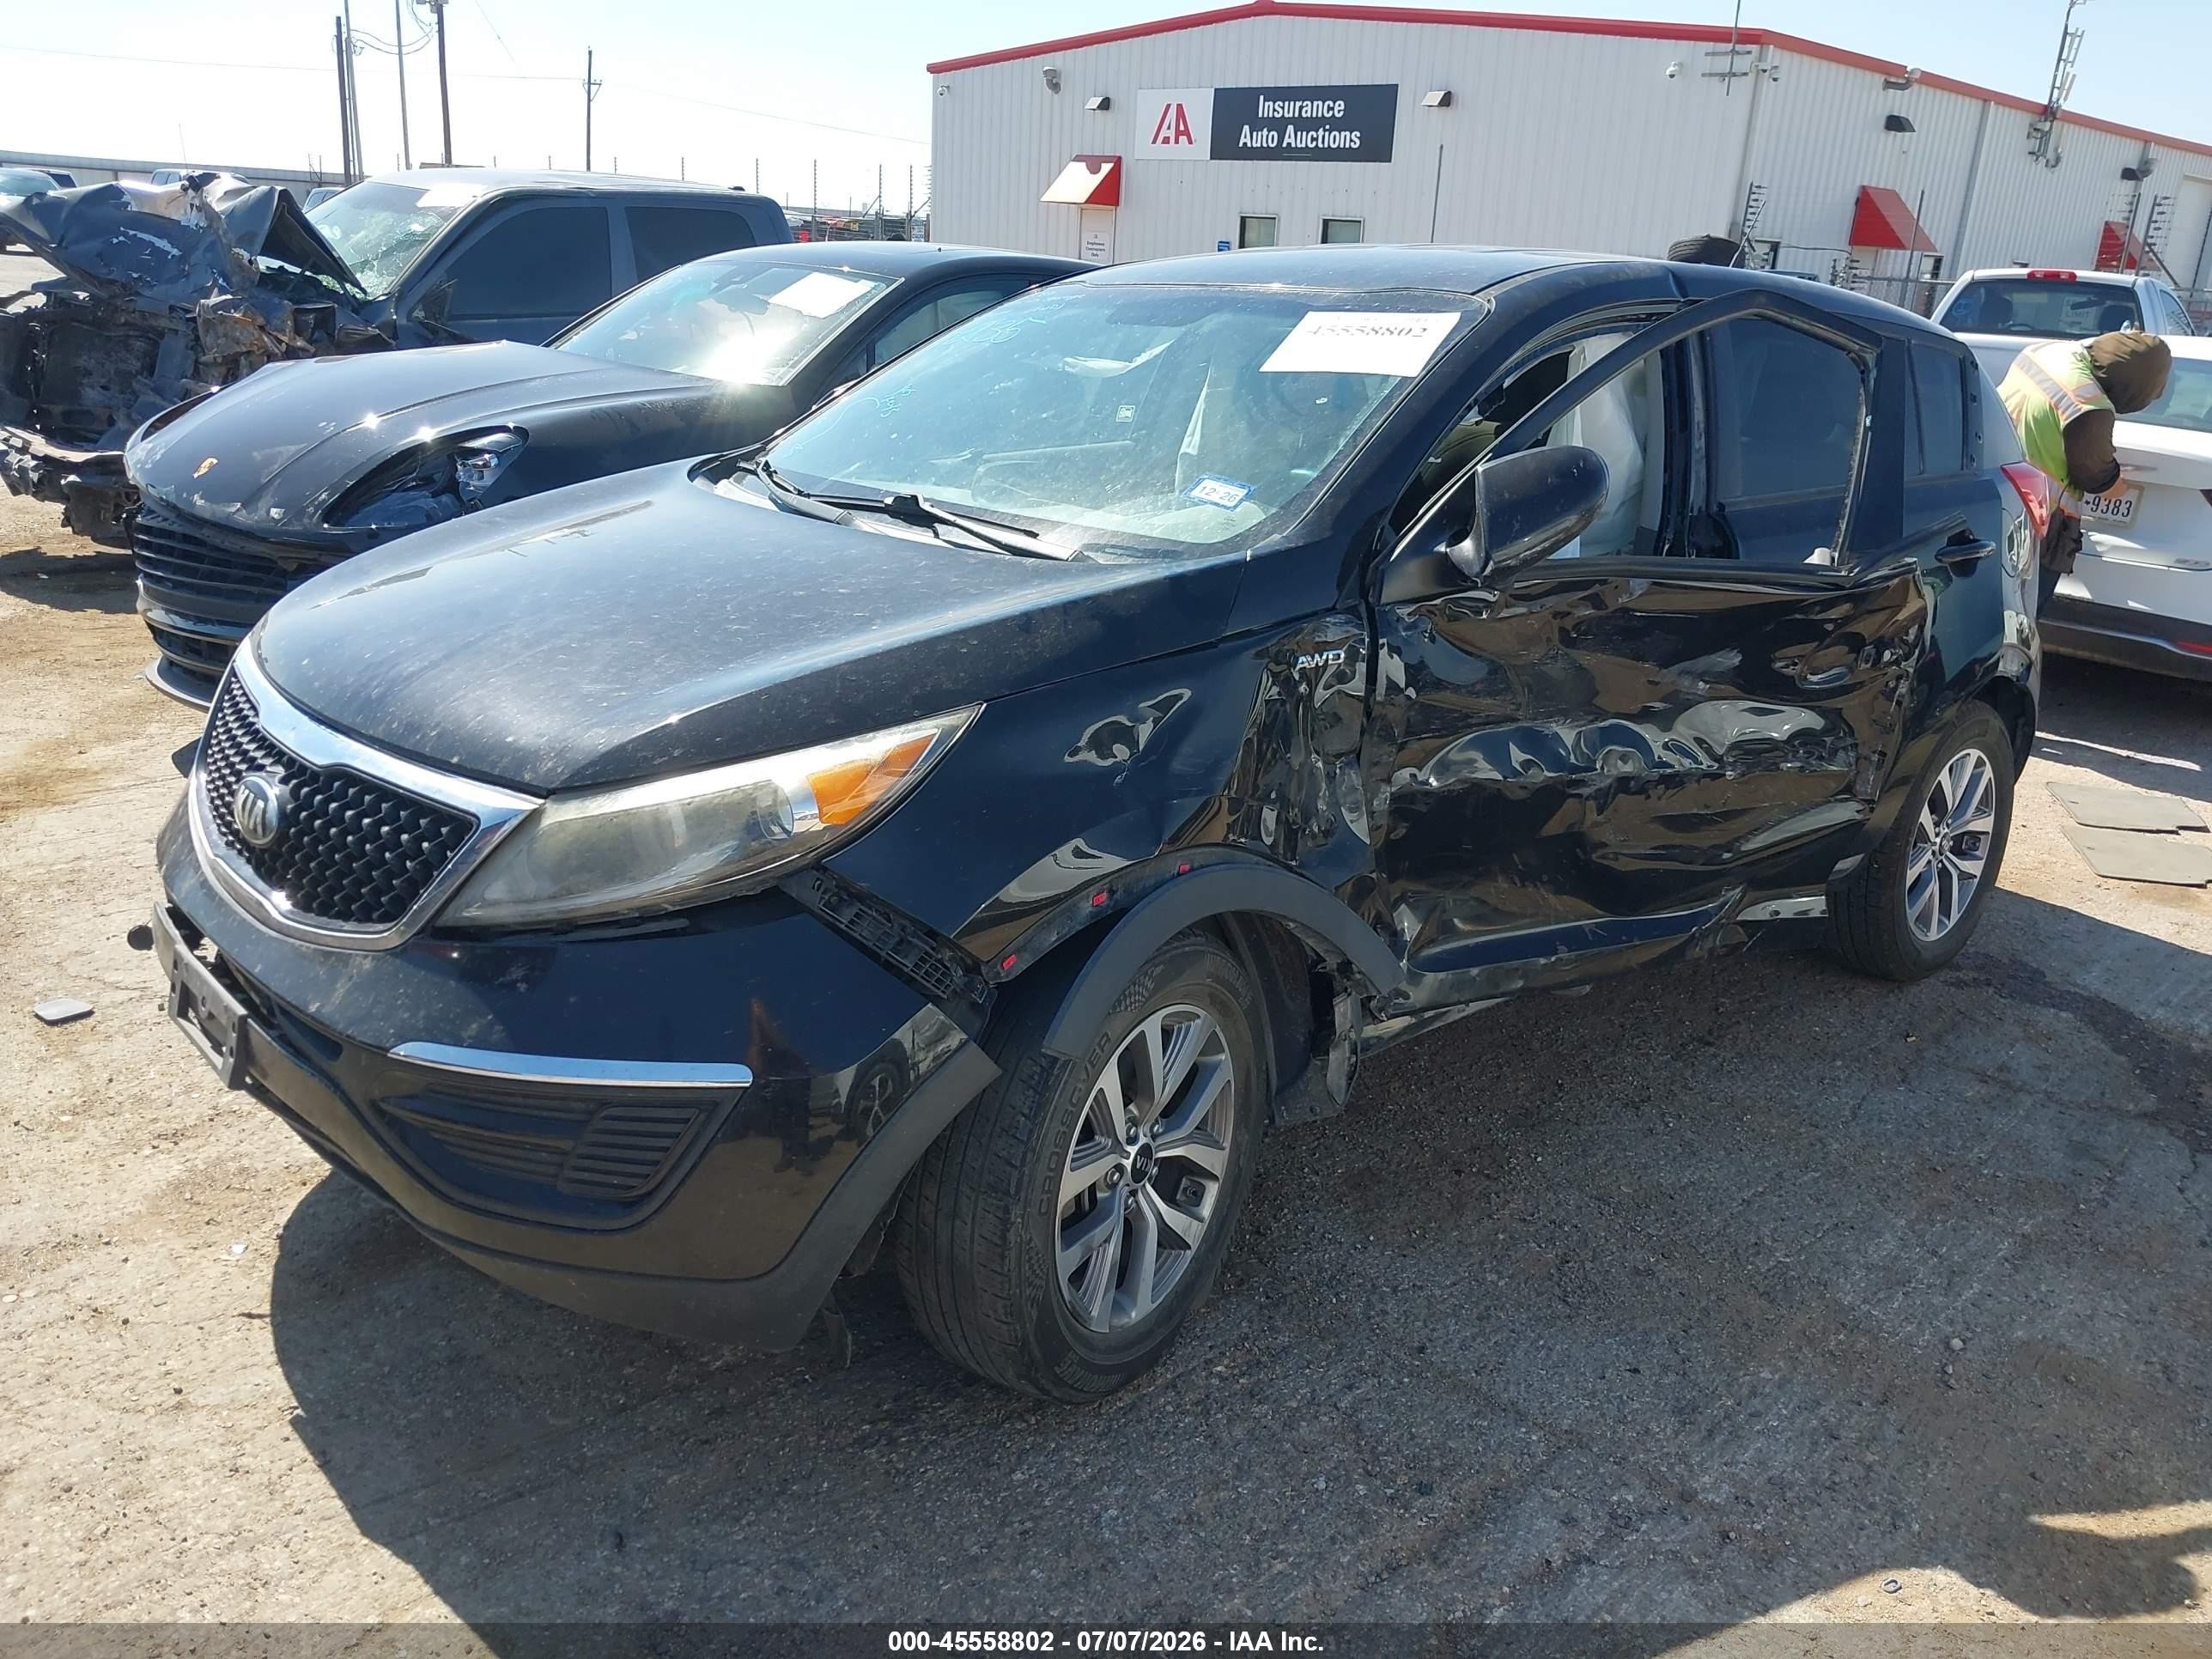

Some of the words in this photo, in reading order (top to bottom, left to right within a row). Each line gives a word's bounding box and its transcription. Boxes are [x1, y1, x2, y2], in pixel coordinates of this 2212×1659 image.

[1258, 94, 1345, 118] Insurance
[1238, 125, 1278, 148] Auto
[1282, 125, 1361, 149] Auctions
[2090, 495, 2132, 518] 9383
[1294, 649, 1345, 672] AWD
